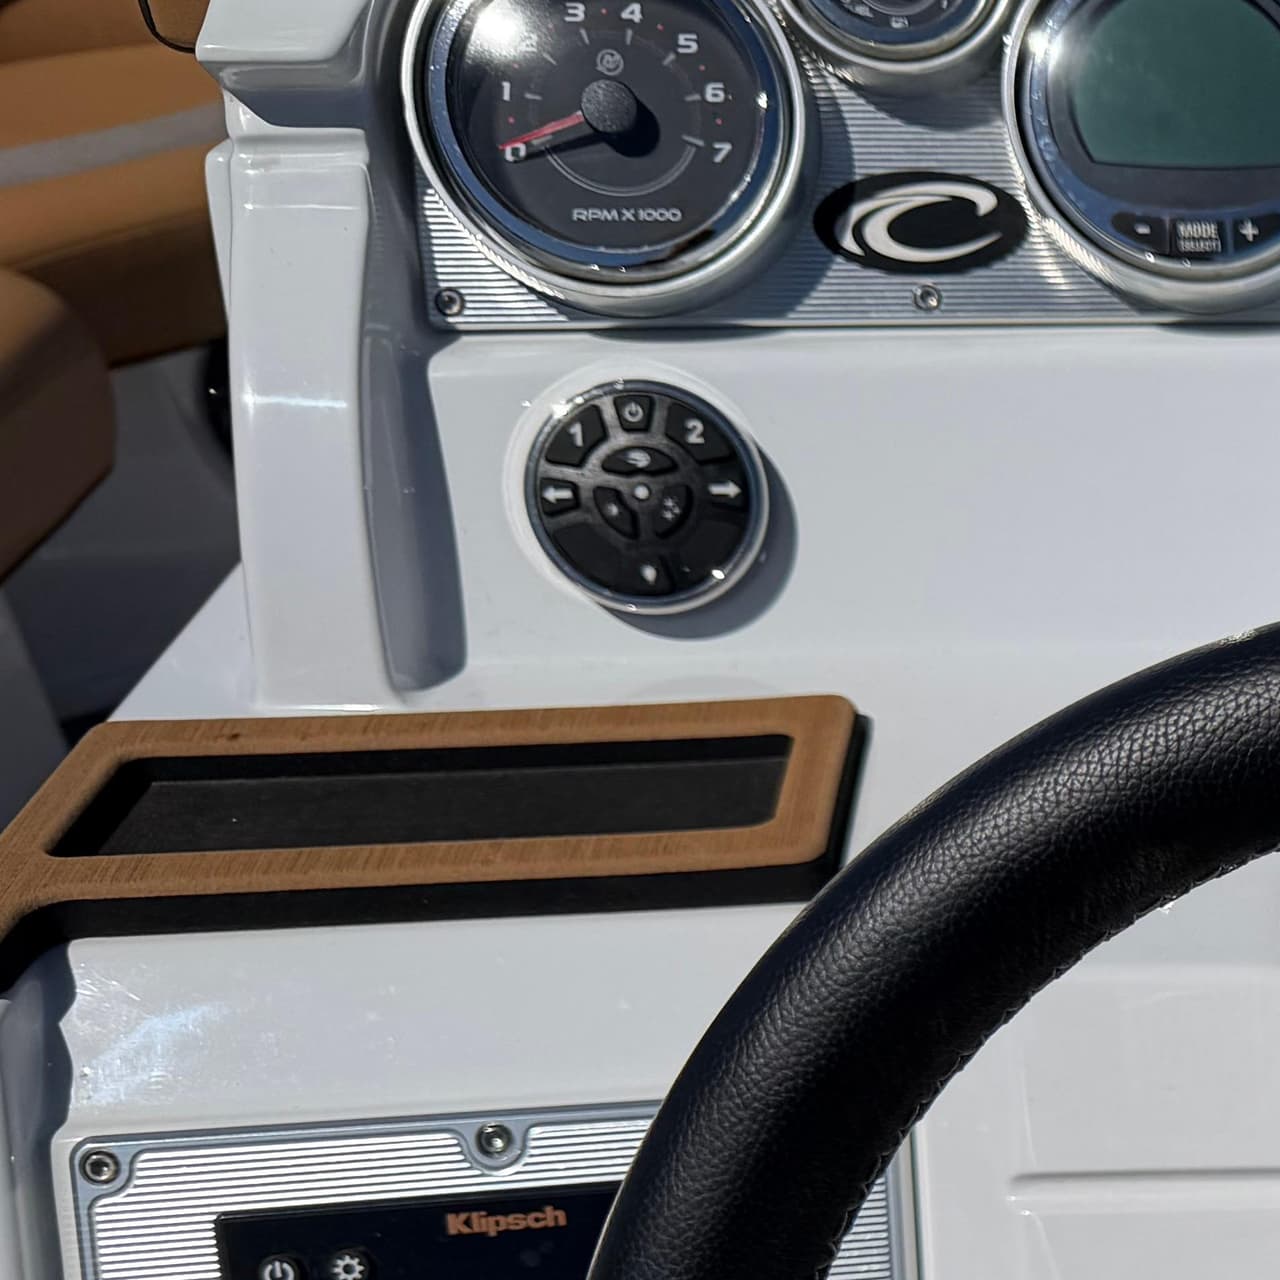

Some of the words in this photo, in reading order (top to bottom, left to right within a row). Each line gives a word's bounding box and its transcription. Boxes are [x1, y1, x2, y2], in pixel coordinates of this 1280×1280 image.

[564, 2, 586, 22] 3
[620, 3, 643, 23] 4
[677, 33, 699, 54] 5
[501, 81, 511, 101] 1
[704, 82, 726, 103] 6
[504, 143, 526, 163] 0
[713, 142, 733, 163] 7
[572, 207, 619, 222] RPM
[621, 207, 636, 222] X
[638, 207, 682, 222] 1000
[569, 424, 584, 447] 1
[684, 419, 705, 444] 2
[446, 1206, 567, 1238] Klipsch
